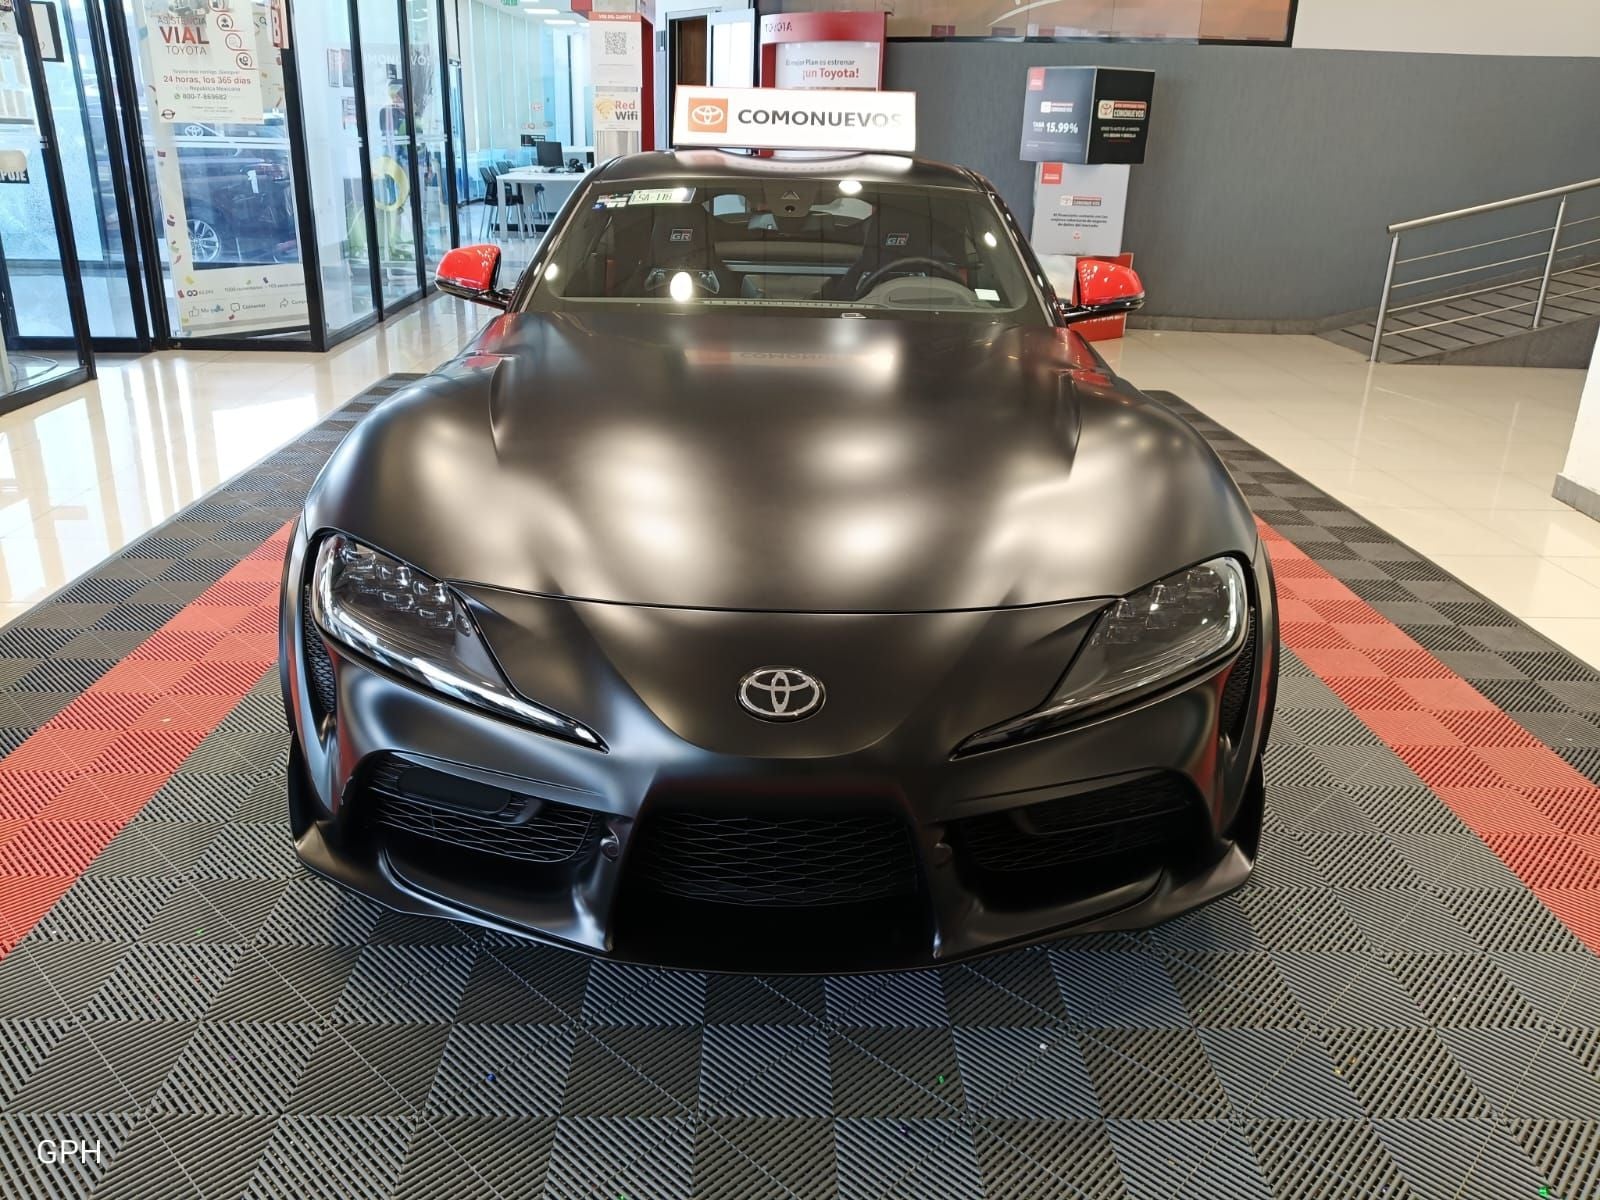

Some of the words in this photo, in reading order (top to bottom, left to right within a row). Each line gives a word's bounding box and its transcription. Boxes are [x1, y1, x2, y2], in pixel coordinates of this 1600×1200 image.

[160, 26, 209, 44] VIAL
[165, 45, 207, 55] TOYOTA
[163, 75, 173, 83] 24
[203, 75, 216, 83] los
[216, 76, 232, 84] 365
[819, 68, 859, 80] Toyota!
[615, 100, 636, 110] Red
[615, 111, 638, 121] Wifi
[737, 109, 903, 128] COMONUEVOS
[1046, 121, 1079, 134] 15.99%
